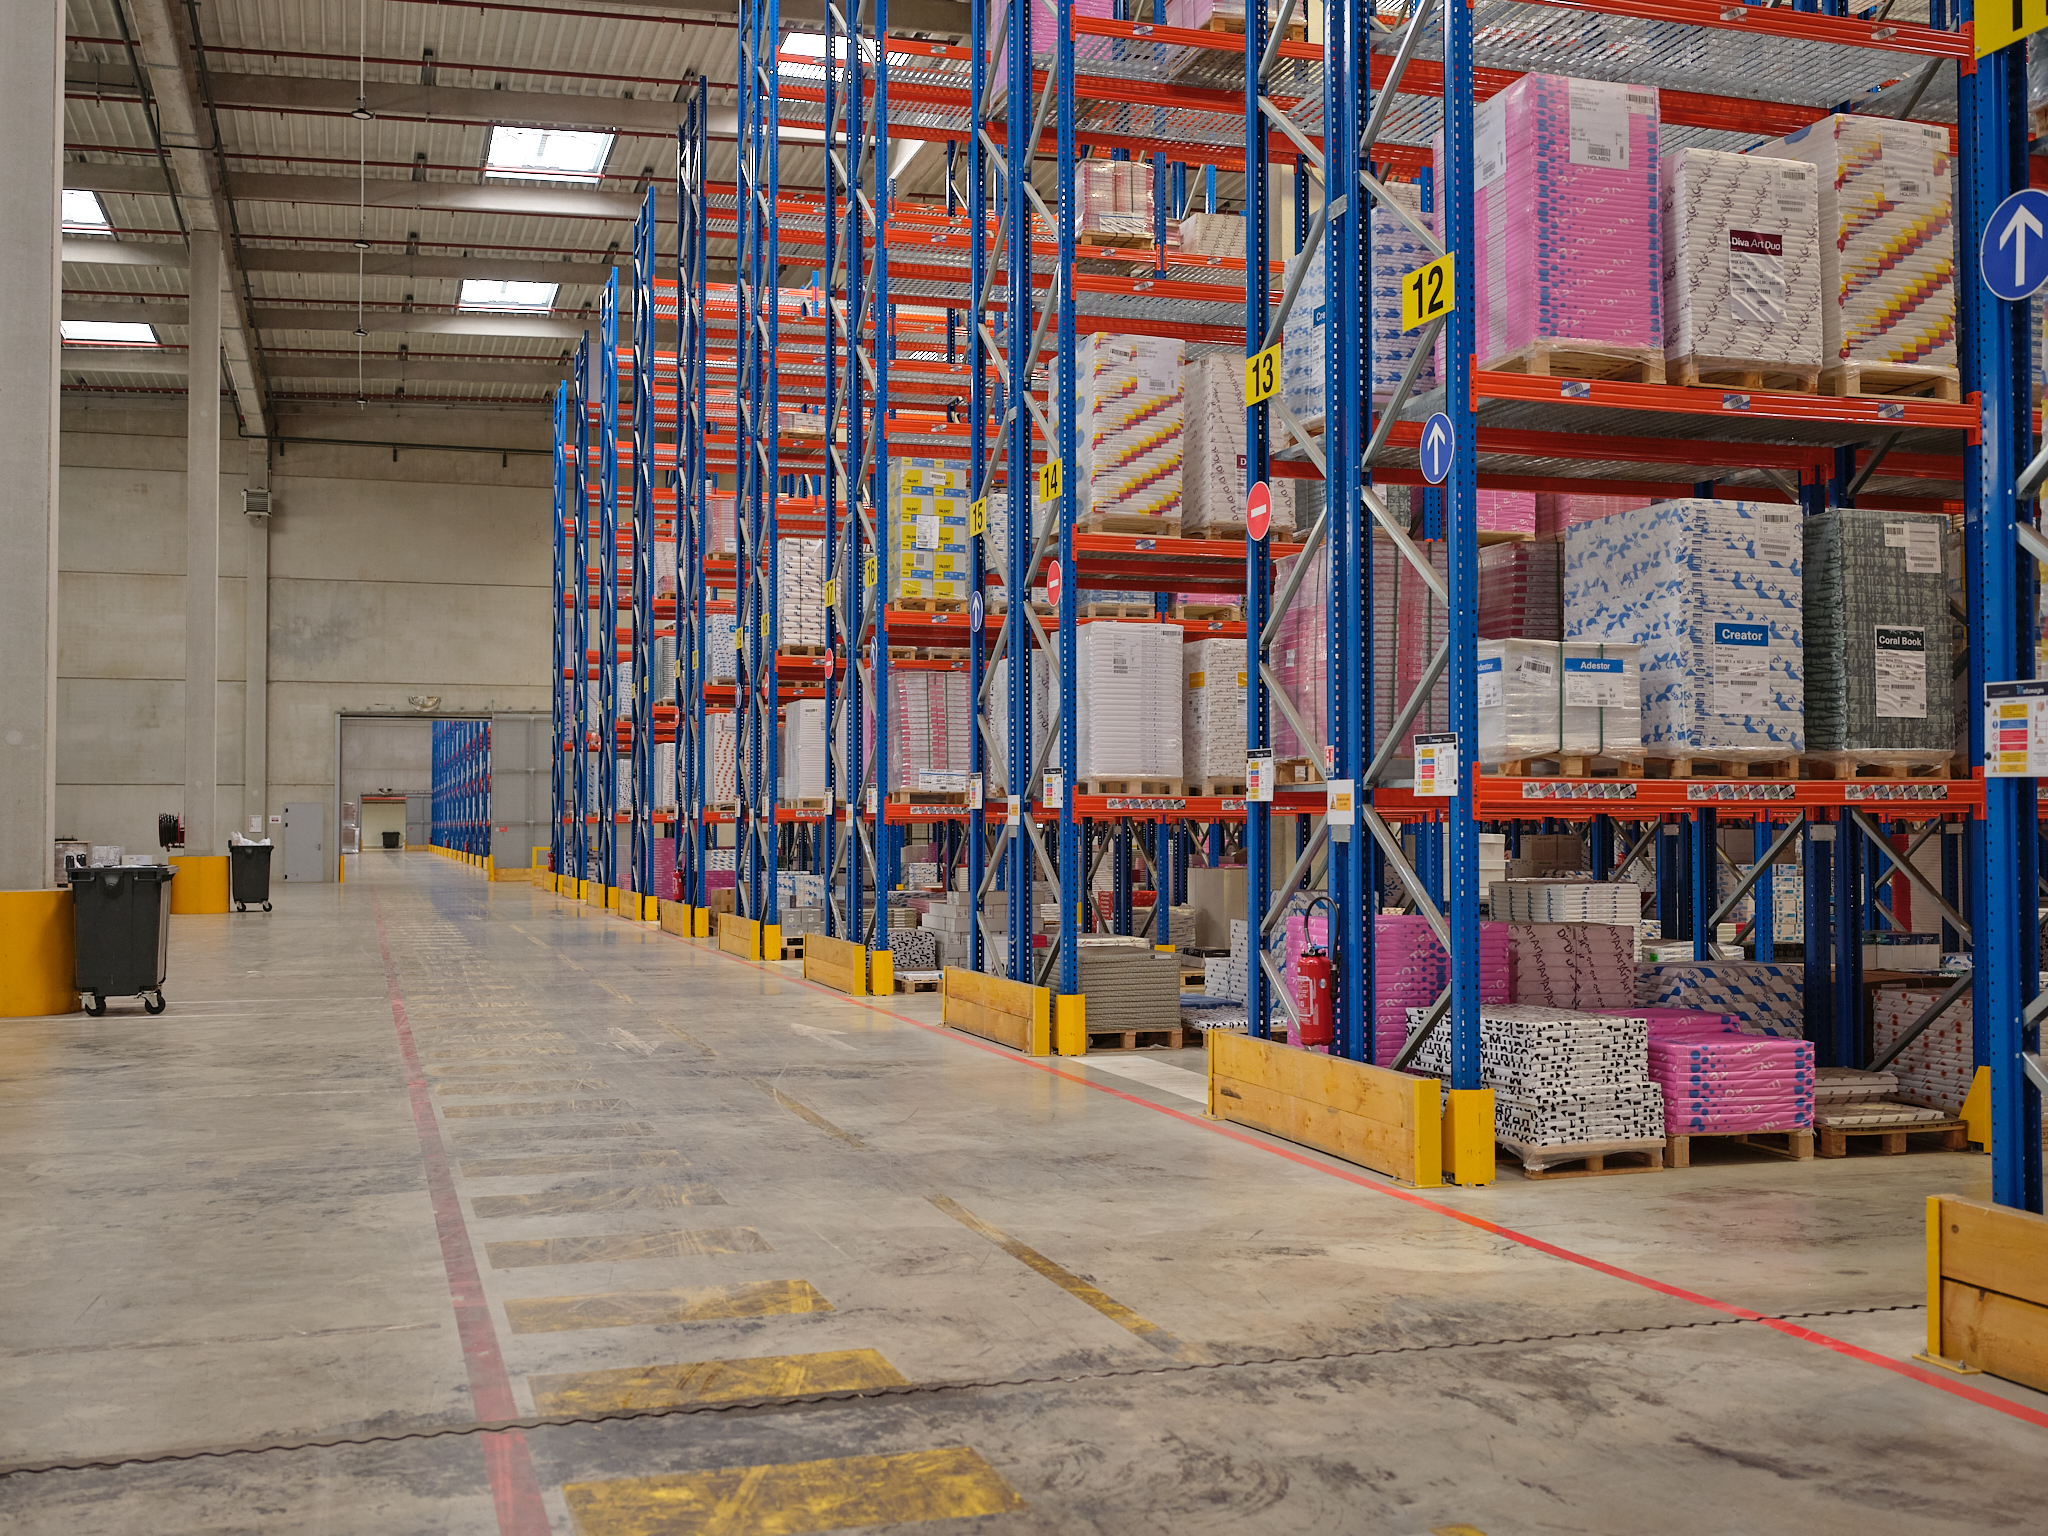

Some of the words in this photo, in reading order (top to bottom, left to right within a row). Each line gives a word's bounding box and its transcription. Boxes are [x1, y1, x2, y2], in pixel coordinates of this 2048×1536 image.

[1732, 237, 1750, 247] Diva
[1750, 239, 1764, 249] Art
[1765, 241, 1780, 250] Duo
[1413, 266, 1444, 319] 12
[1252, 353, 1274, 397] 13
[1044, 464, 1057, 498] 14
[973, 502, 982, 531] 15
[868, 560, 874, 584] 16
[827, 582, 833, 604] 17
[1722, 629, 1763, 641] Creator
[1879, 636, 1900, 645] Coral
[1902, 637, 1922, 646] Book
[1580, 661, 1610, 670] Adestor
